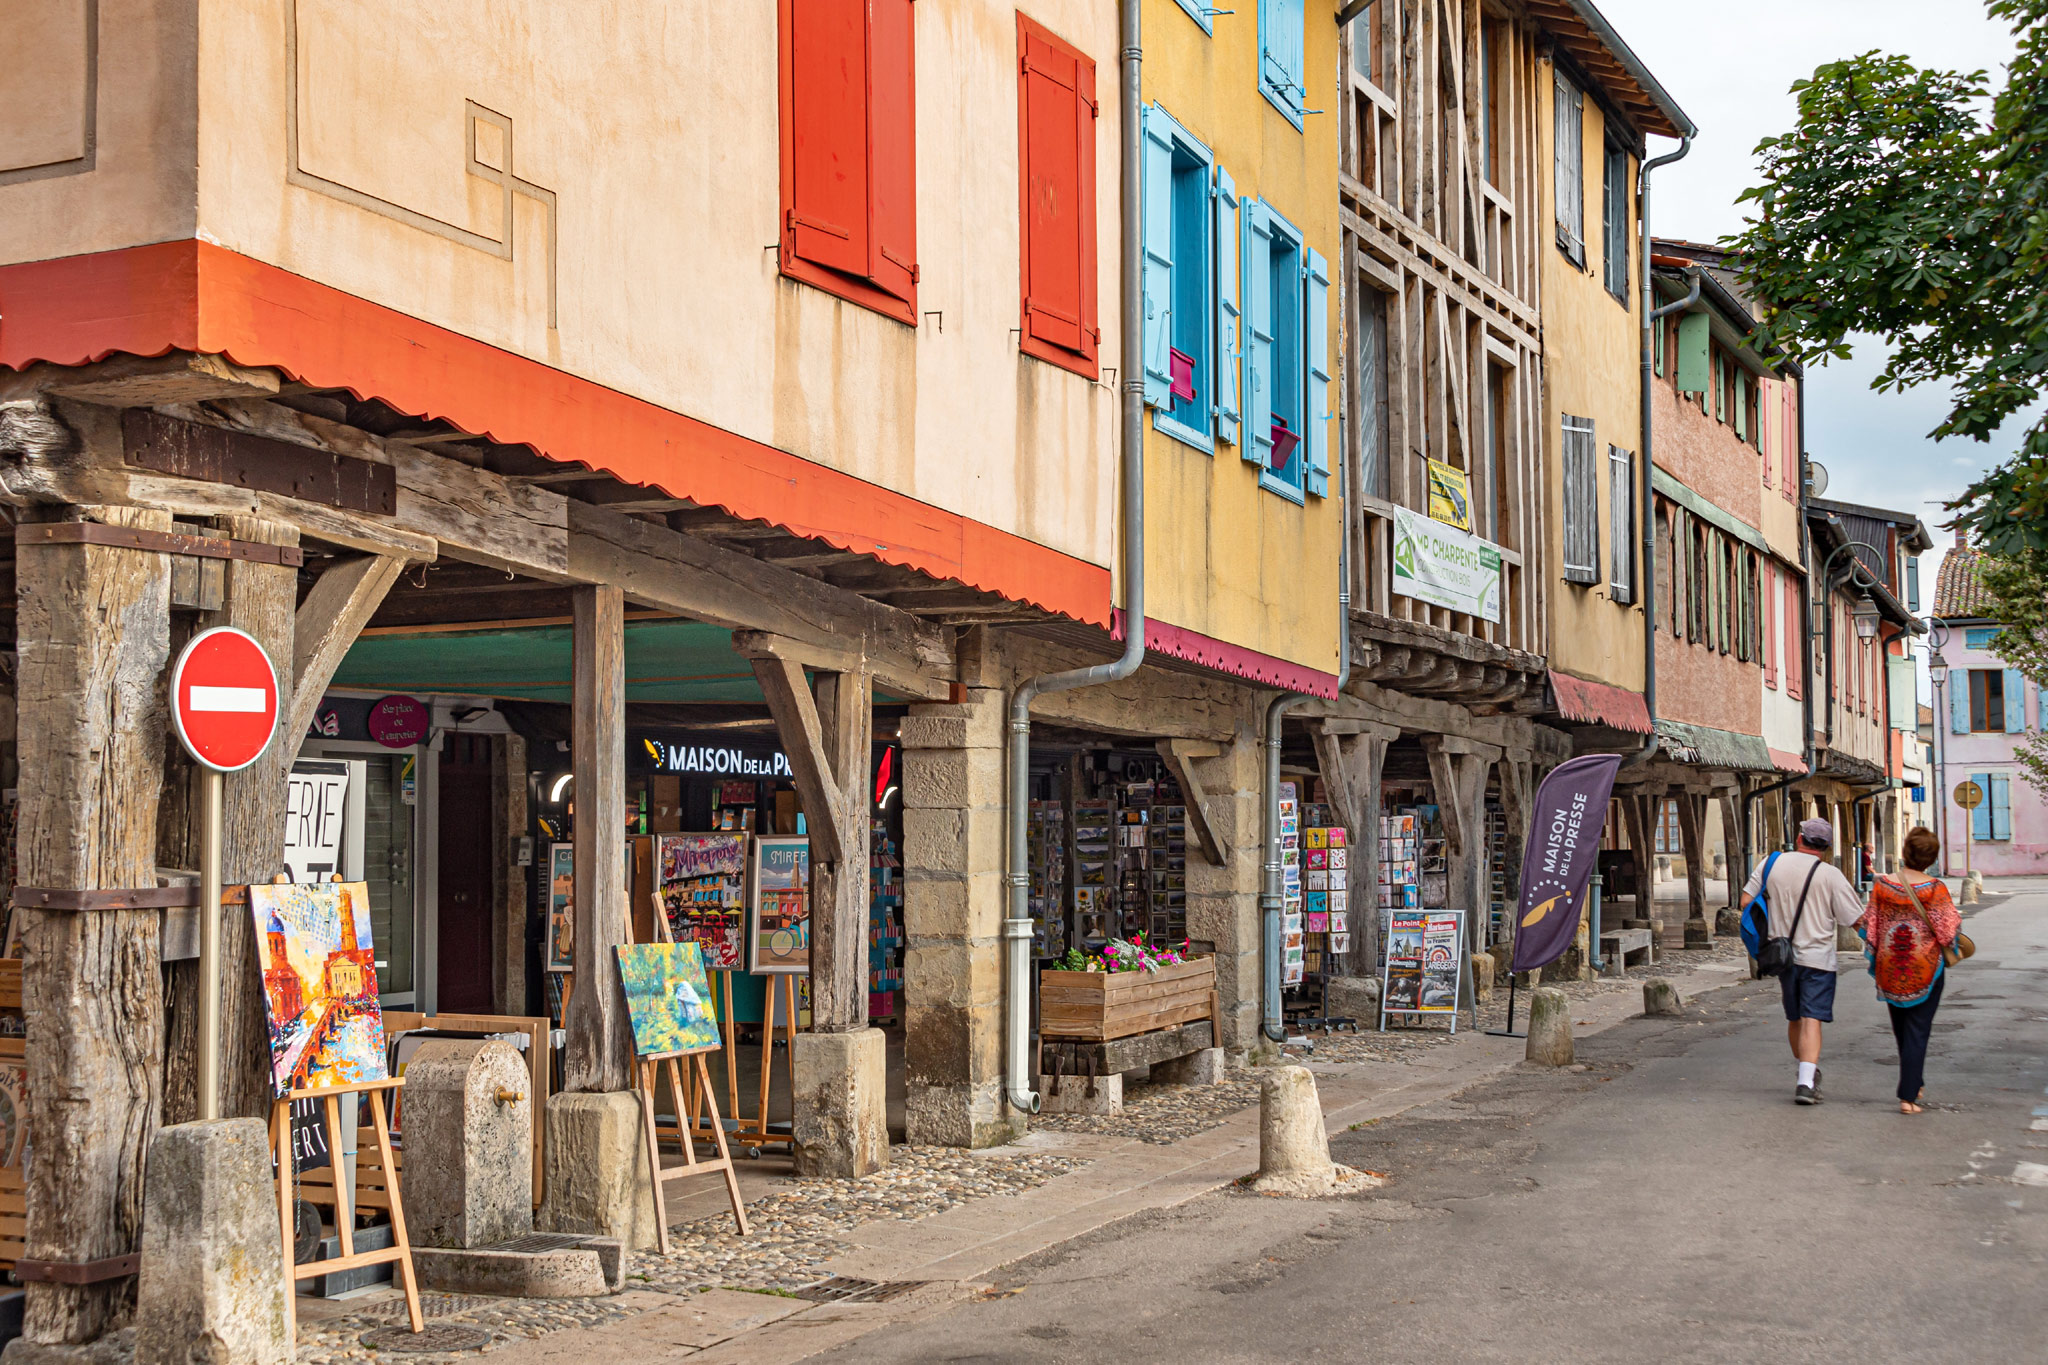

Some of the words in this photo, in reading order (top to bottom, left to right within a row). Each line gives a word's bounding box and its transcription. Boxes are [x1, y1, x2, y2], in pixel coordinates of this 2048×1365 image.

[1432, 538, 1478, 572] CHARPENTE
[669, 745, 742, 774] MAISON
[743, 758, 757, 774] DE
[758, 759, 772, 775] LA
[1564, 792, 1587, 849] PRESSE
[1542, 808, 1568, 873] MAISON
[675, 841, 736, 872] Mirepoix
[770, 850, 807, 864] MIREP
[1559, 862, 1570, 876] DE
[1562, 850, 1573, 862] LA
